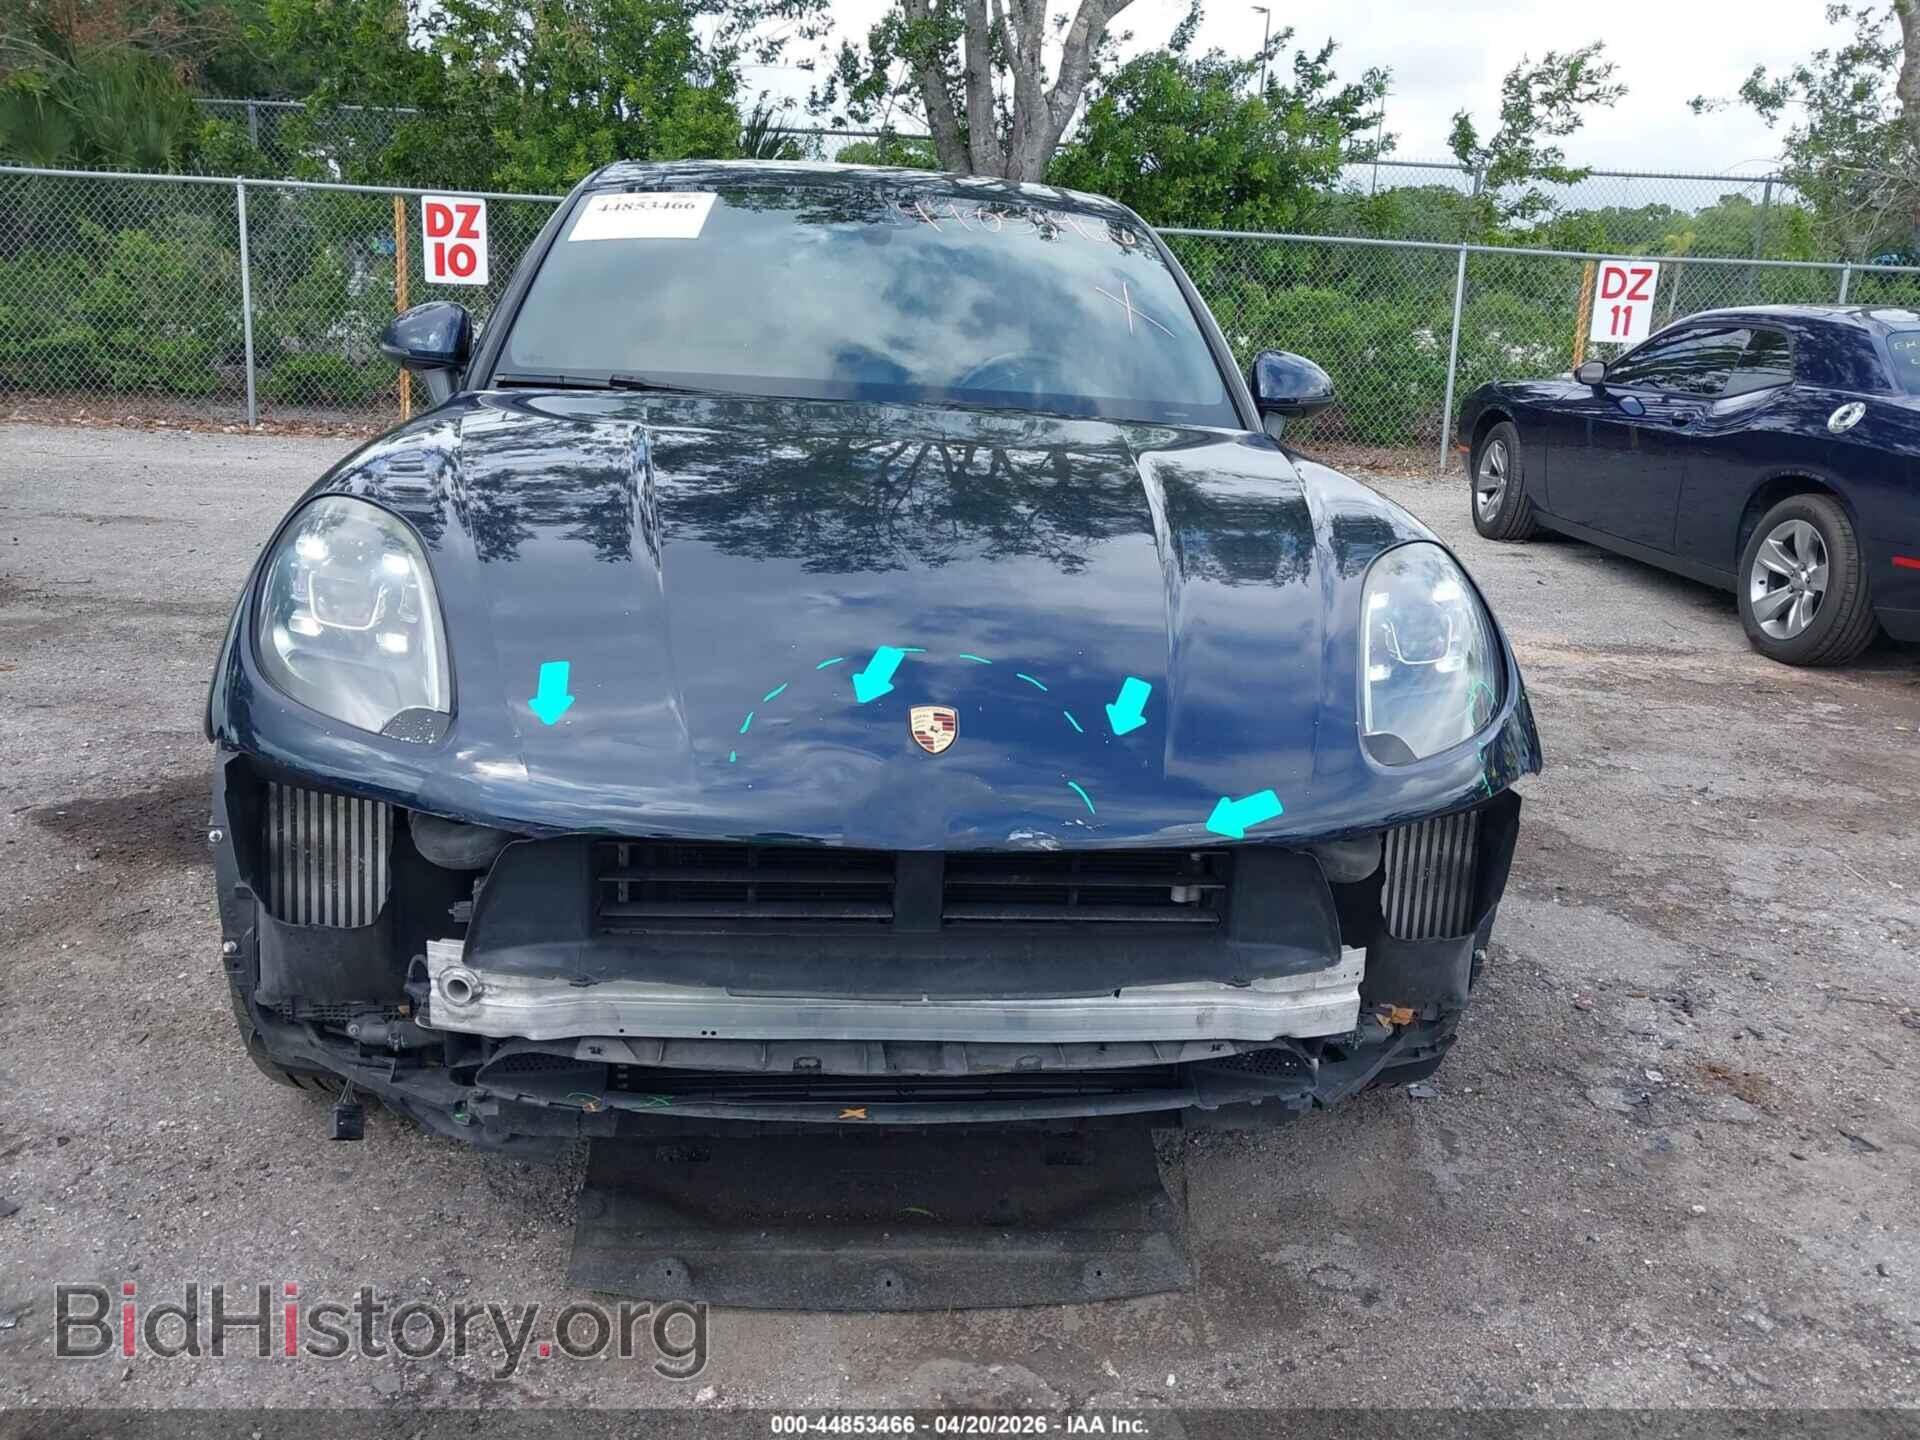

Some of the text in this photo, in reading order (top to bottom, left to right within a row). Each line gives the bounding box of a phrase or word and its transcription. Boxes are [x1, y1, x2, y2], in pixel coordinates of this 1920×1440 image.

[426, 203, 481, 239] DZ
[1601, 266, 1653, 301] DZ
[1611, 304, 1633, 336] 11
